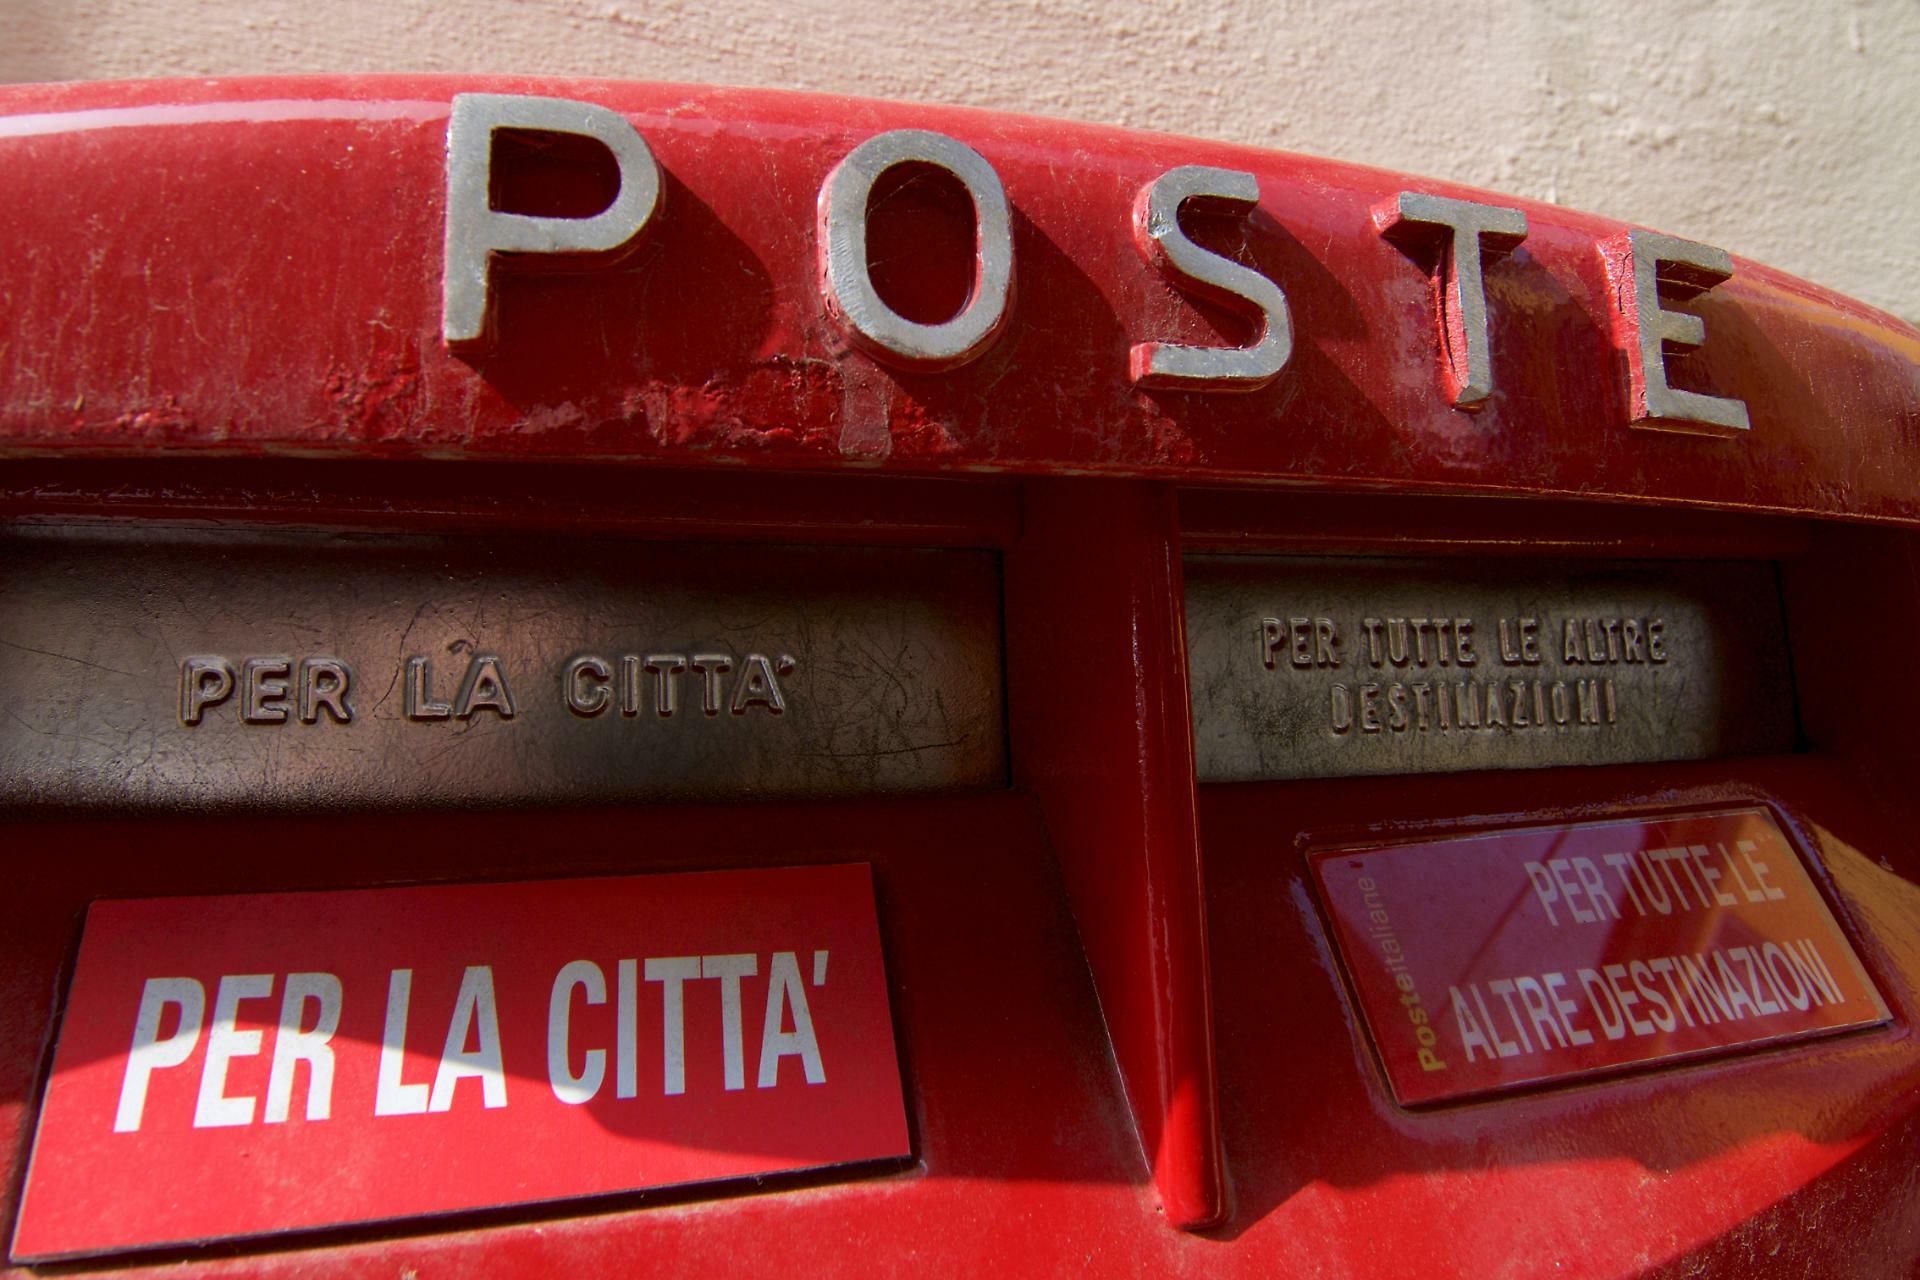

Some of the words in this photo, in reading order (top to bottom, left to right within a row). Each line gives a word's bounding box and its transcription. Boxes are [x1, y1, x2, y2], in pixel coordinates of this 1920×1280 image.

[442, 92, 1750, 438] POSTE
[1262, 617, 1340, 669] PER
[1364, 617, 1477, 667] TUTTE
[1499, 617, 1541, 666] LE
[1563, 617, 1667, 664] ALTRE
[181, 655, 353, 726] PER
[404, 654, 517, 720] LA
[563, 652, 797, 718] CITTA'
[1330, 679, 1617, 735] DESTINAZIONI
[1525, 852, 1622, 926] PER
[1607, 845, 1738, 916] TUTTE
[1716, 839, 1785, 906] LE
[113, 972, 343, 1133] PER
[374, 965, 508, 1117] LA
[547, 949, 829, 1105] CITTA'
[1448, 972, 1594, 1063] ALTRE
[1578, 939, 1845, 1042] DESTINAZIONI
